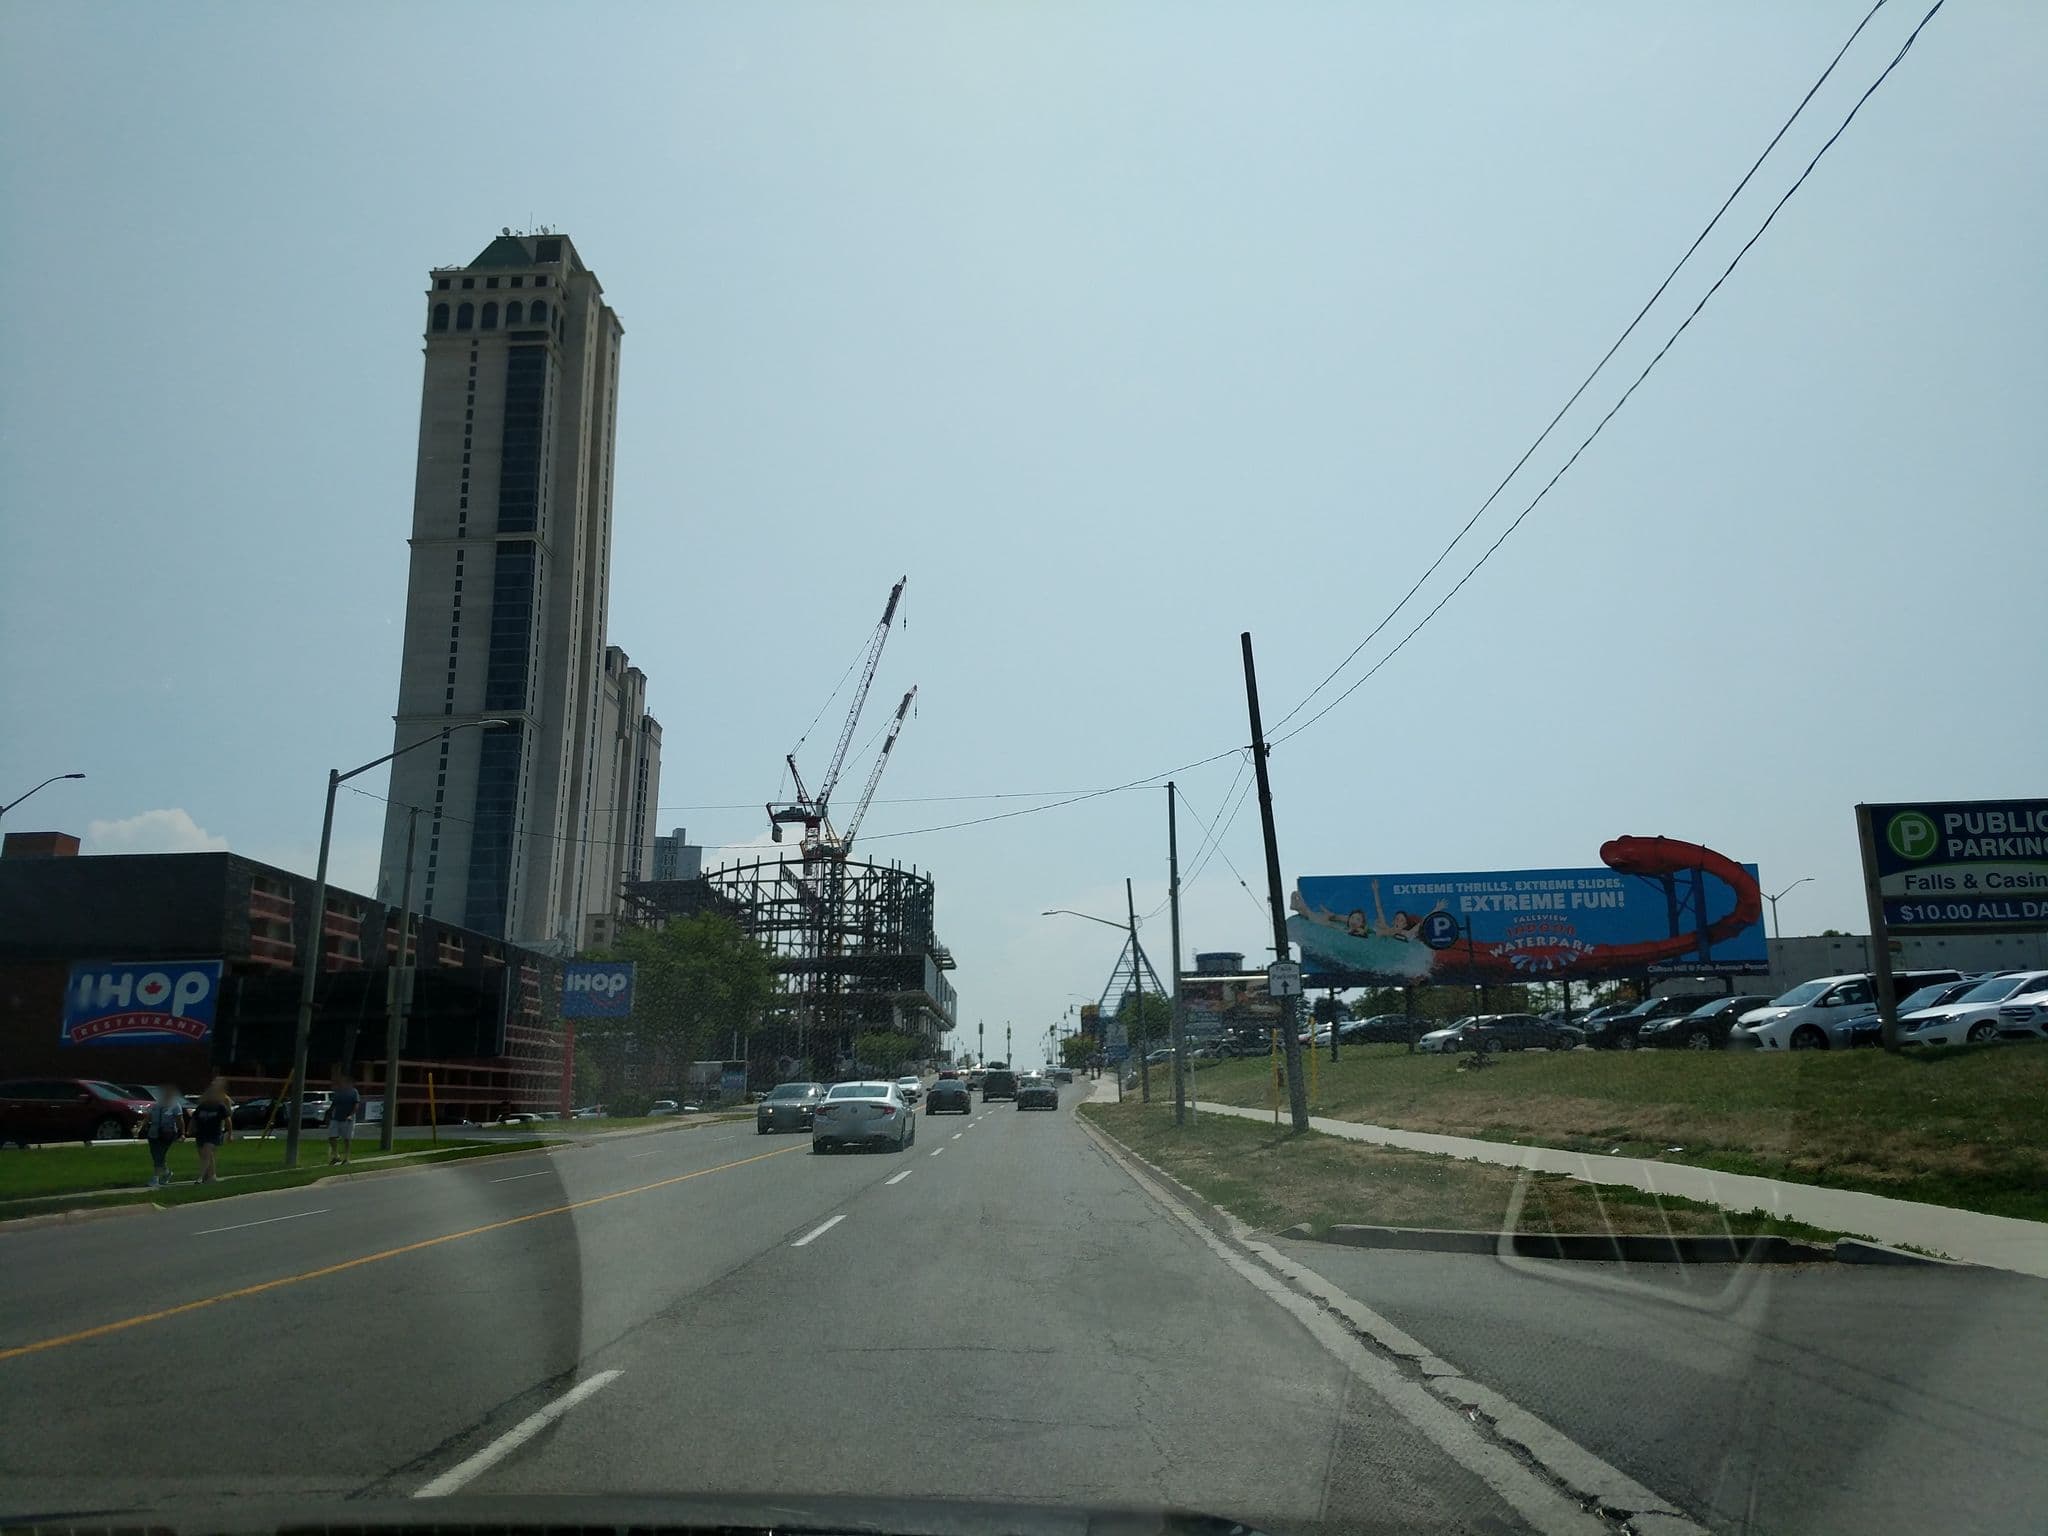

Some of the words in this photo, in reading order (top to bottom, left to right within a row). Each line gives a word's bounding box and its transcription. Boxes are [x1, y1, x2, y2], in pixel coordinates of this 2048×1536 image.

[1944, 810, 2048, 835] PUBLIC
[1900, 820, 1927, 852] P
[1947, 837, 2048, 857] PARKIN
[1393, 883, 1454, 895] EXTREME
[1455, 881, 1512, 893] THRILLS.
[1515, 879, 1575, 891] EXTREME
[1577, 878, 1624, 889] SLIDES.
[1904, 873, 1956, 890] Falls
[1963, 873, 1978, 889] &
[1460, 891, 1566, 912] EXTREME
[1571, 890, 1625, 909] FUN!
[1513, 914, 1568, 923] FALLSVIEW
[1900, 904, 1973, 921] $10.00
[1977, 903, 2021, 919] ALL
[1489, 935, 1596, 958] WATERPARK
[79, 971, 210, 1017] IHOP
[567, 973, 627, 998] IHOP
[79, 1016, 199, 1036] RESTAURANT
